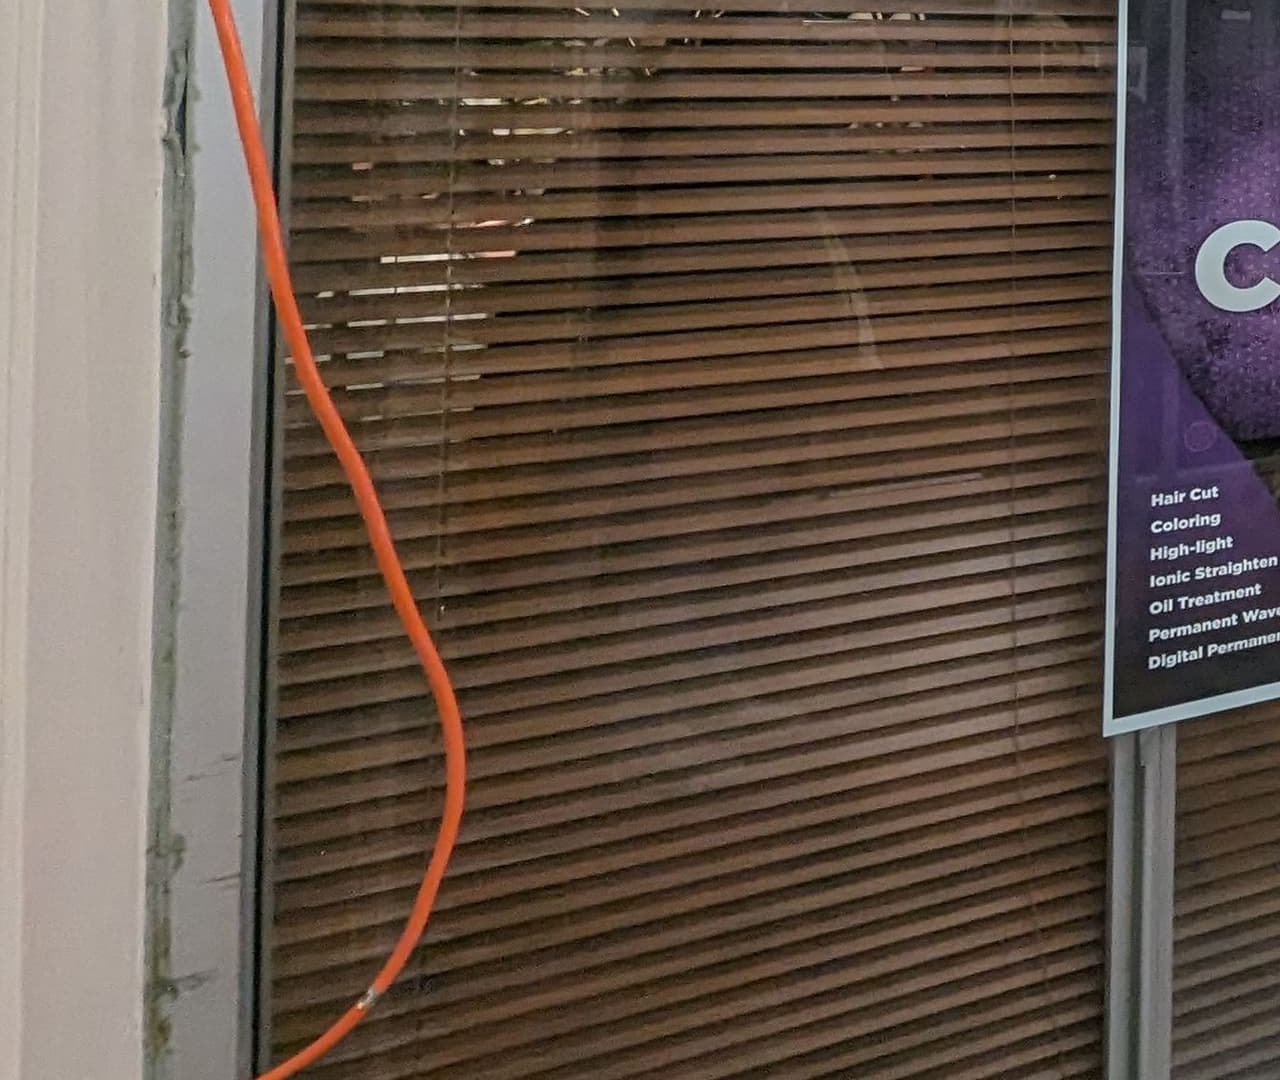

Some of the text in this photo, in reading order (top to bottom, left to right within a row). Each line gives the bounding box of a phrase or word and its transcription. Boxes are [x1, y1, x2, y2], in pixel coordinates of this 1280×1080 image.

[1150, 485, 1219, 507] Hair Cut
[1150, 513, 1222, 533] Coloring
[1150, 535, 1234, 561] High-light
[1150, 555, 1279, 588] Ionic Straighten
[1150, 583, 1262, 615] Oil Treatment
[1149, 613, 1238, 642] Permanent
[1148, 647, 1204, 670] Digital
